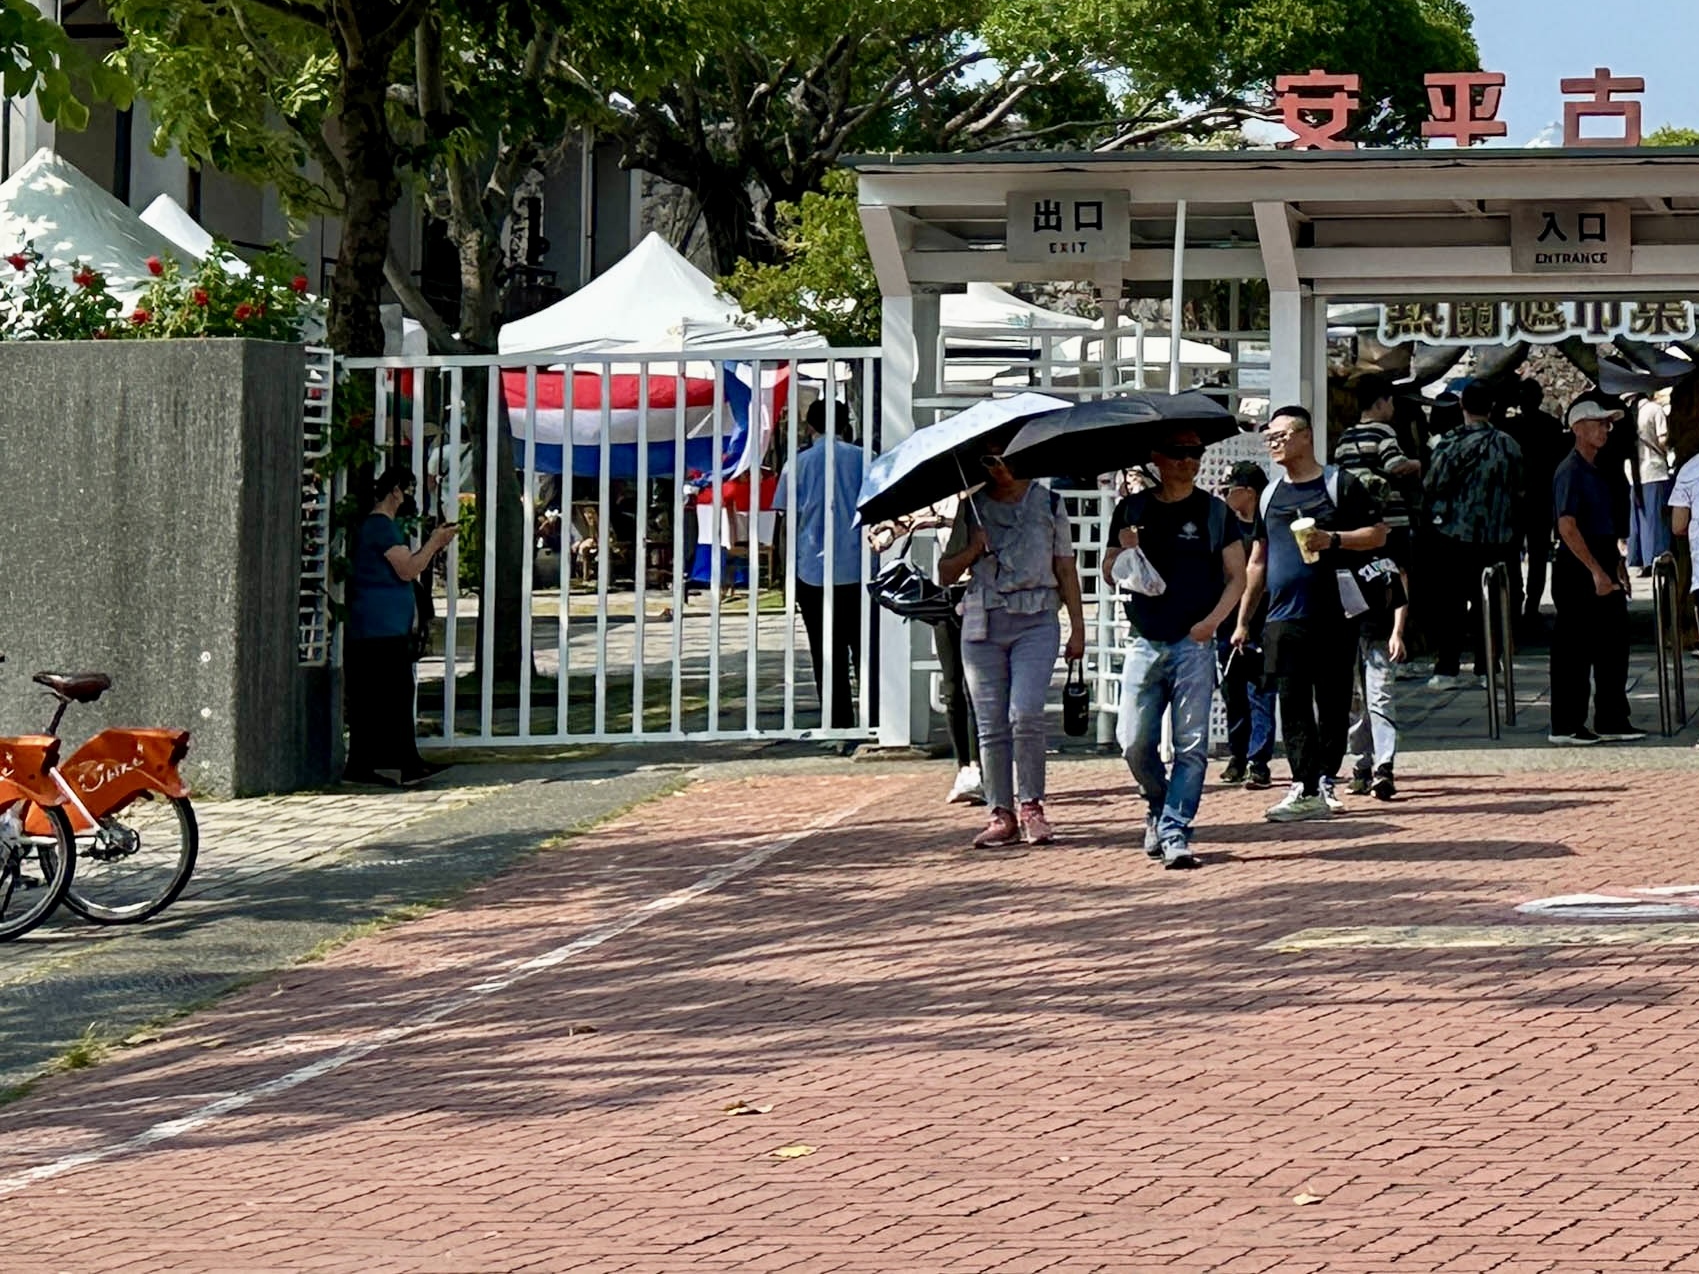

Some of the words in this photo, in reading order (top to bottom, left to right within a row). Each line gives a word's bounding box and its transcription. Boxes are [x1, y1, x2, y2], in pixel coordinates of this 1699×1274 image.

[1033, 200, 1103, 232] 出口
[1537, 212, 1607, 242] 入口
[1049, 241, 1087, 253] EXIT
[1535, 252, 1608, 264] ENTRANCE
